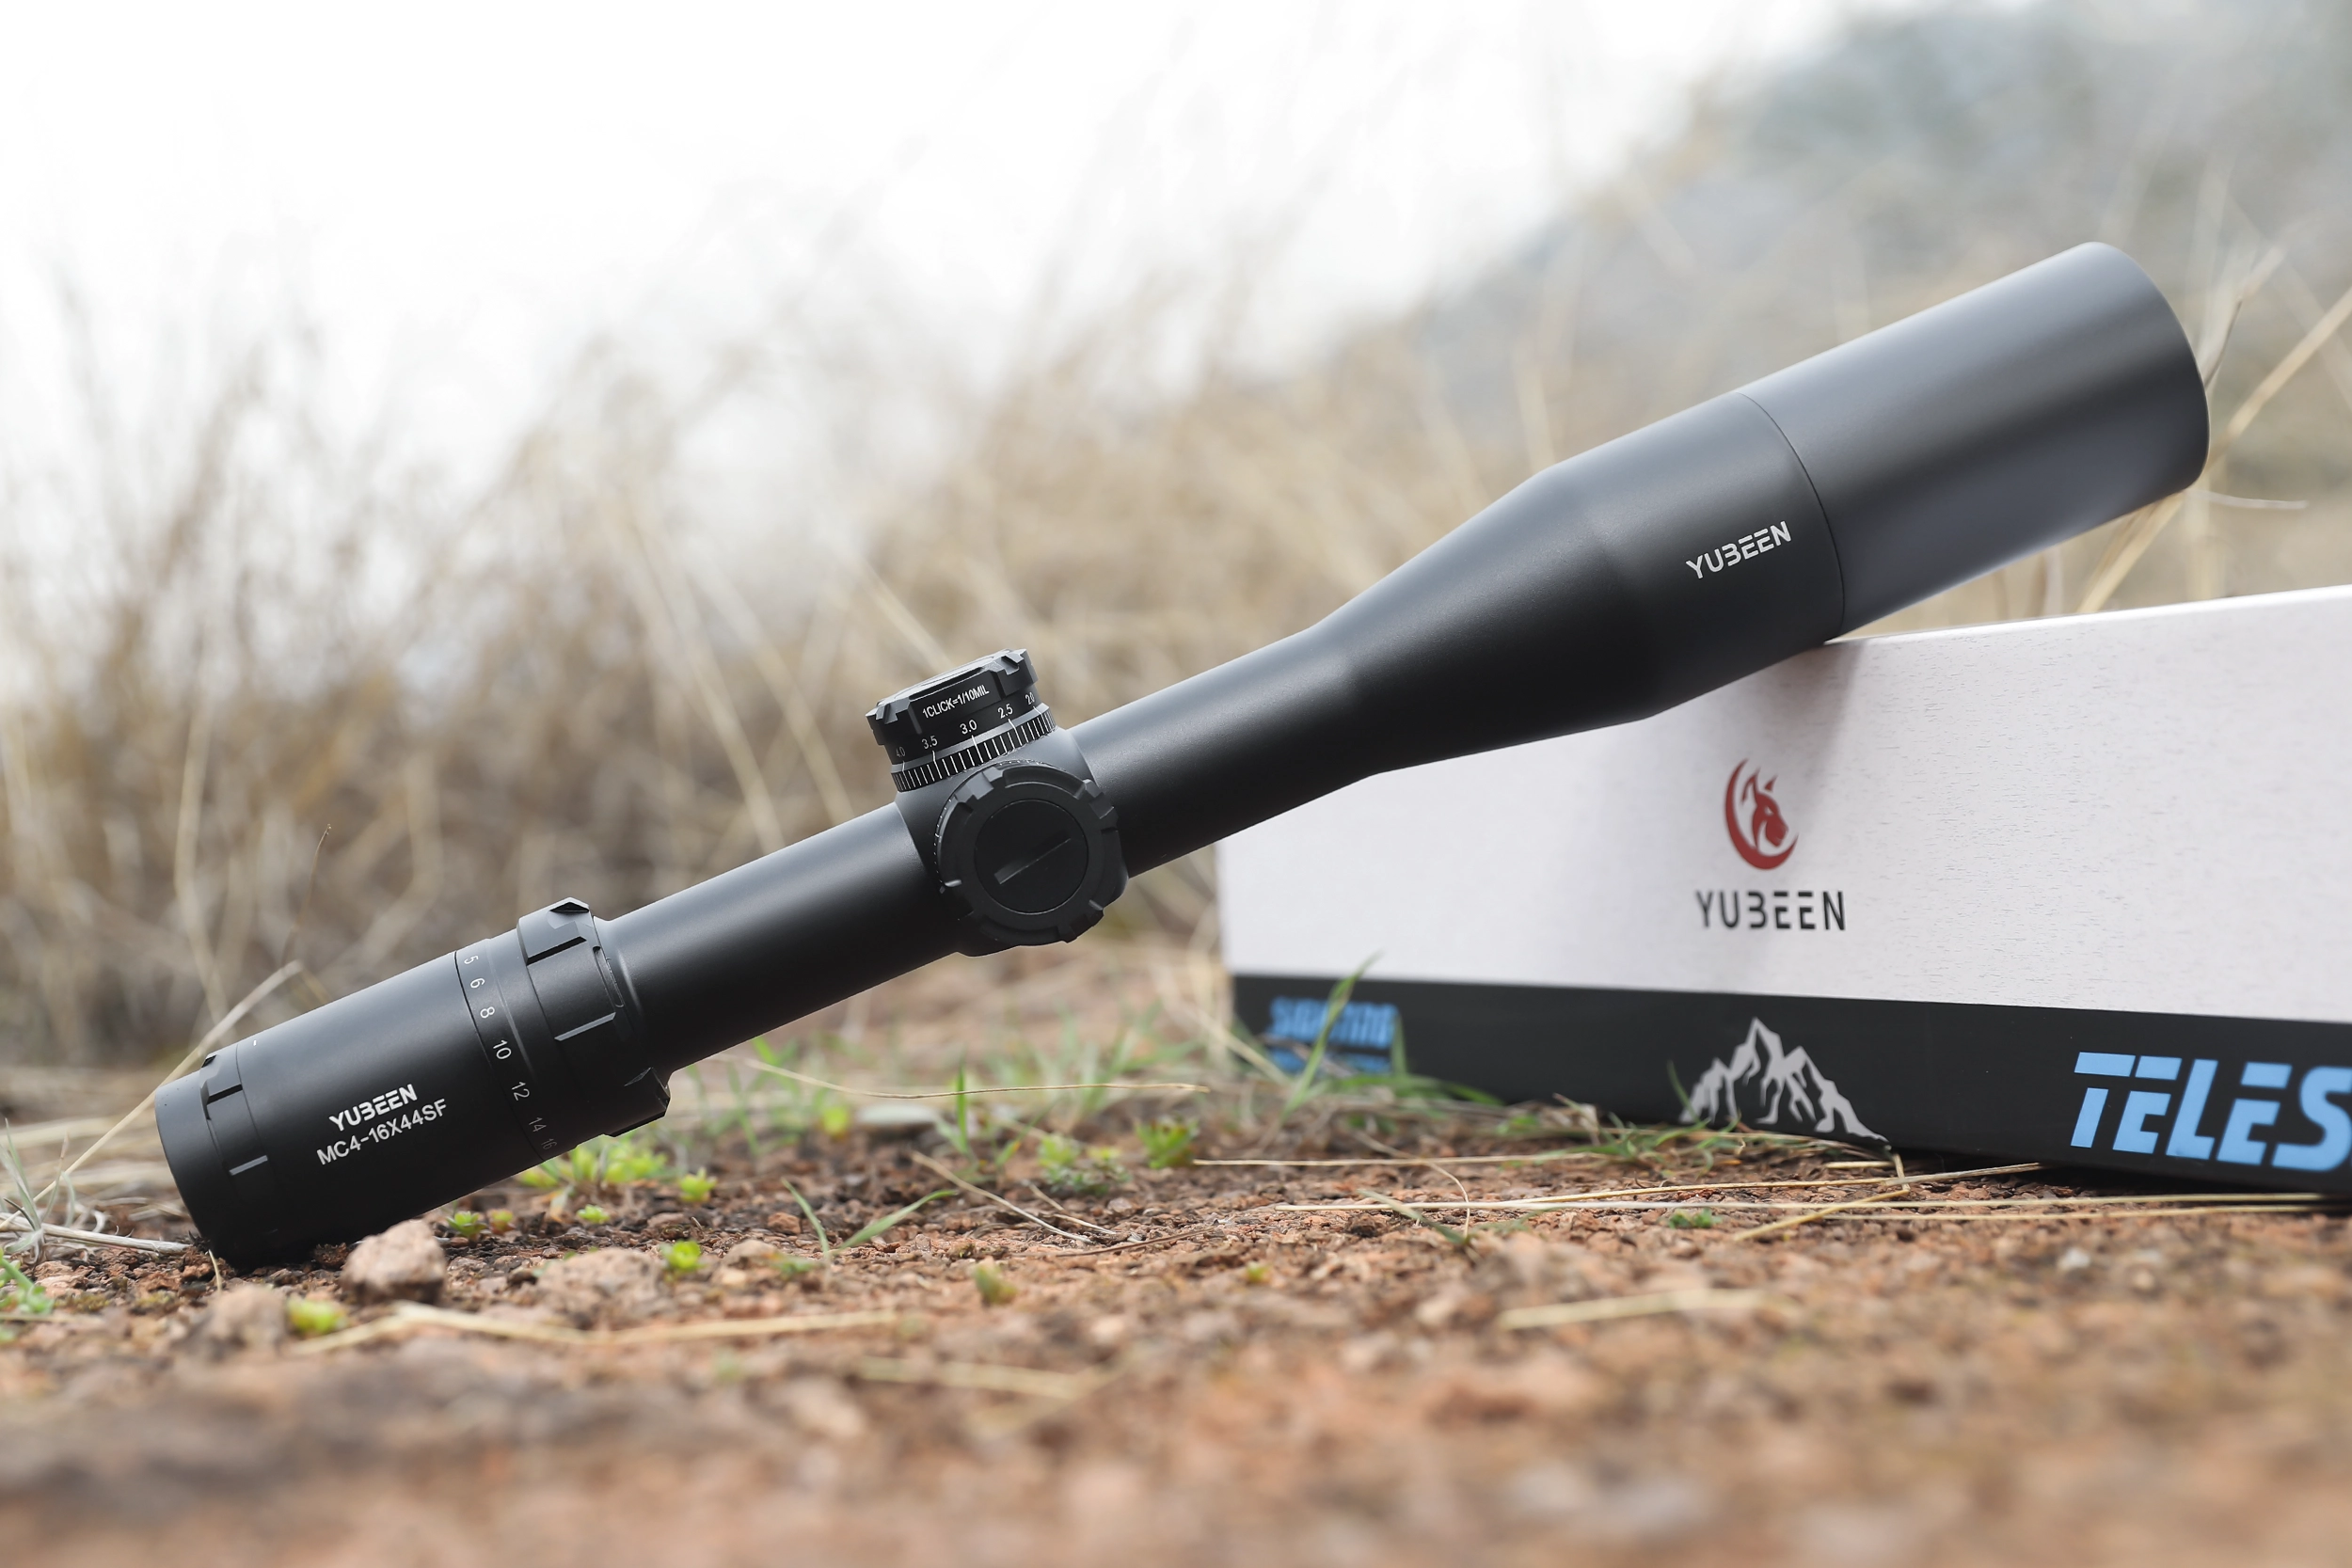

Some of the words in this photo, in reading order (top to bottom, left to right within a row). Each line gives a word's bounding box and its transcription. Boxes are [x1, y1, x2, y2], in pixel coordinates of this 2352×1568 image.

[1685, 520, 1792, 579] YUBEEN
[922, 684, 990, 720] 1CLICK=1/10MIL
[921, 735, 938, 750] 3.5
[959, 719, 977, 736] 3.0
[997, 703, 1014, 720] 2.5
[1695, 890, 1846, 931] YUBEEN
[464, 955, 479, 965] 5
[470, 977, 485, 989] 6
[480, 1006, 496, 1019] 8
[492, 1039, 512, 1060] 10
[511, 1082, 531, 1101] 12
[328, 1084, 418, 1132] YUBEEN
[316, 1098, 447, 1165] MC4-16X44SF
[528, 1117, 547, 1132] 14
[541, 1137, 558, 1150] 16
